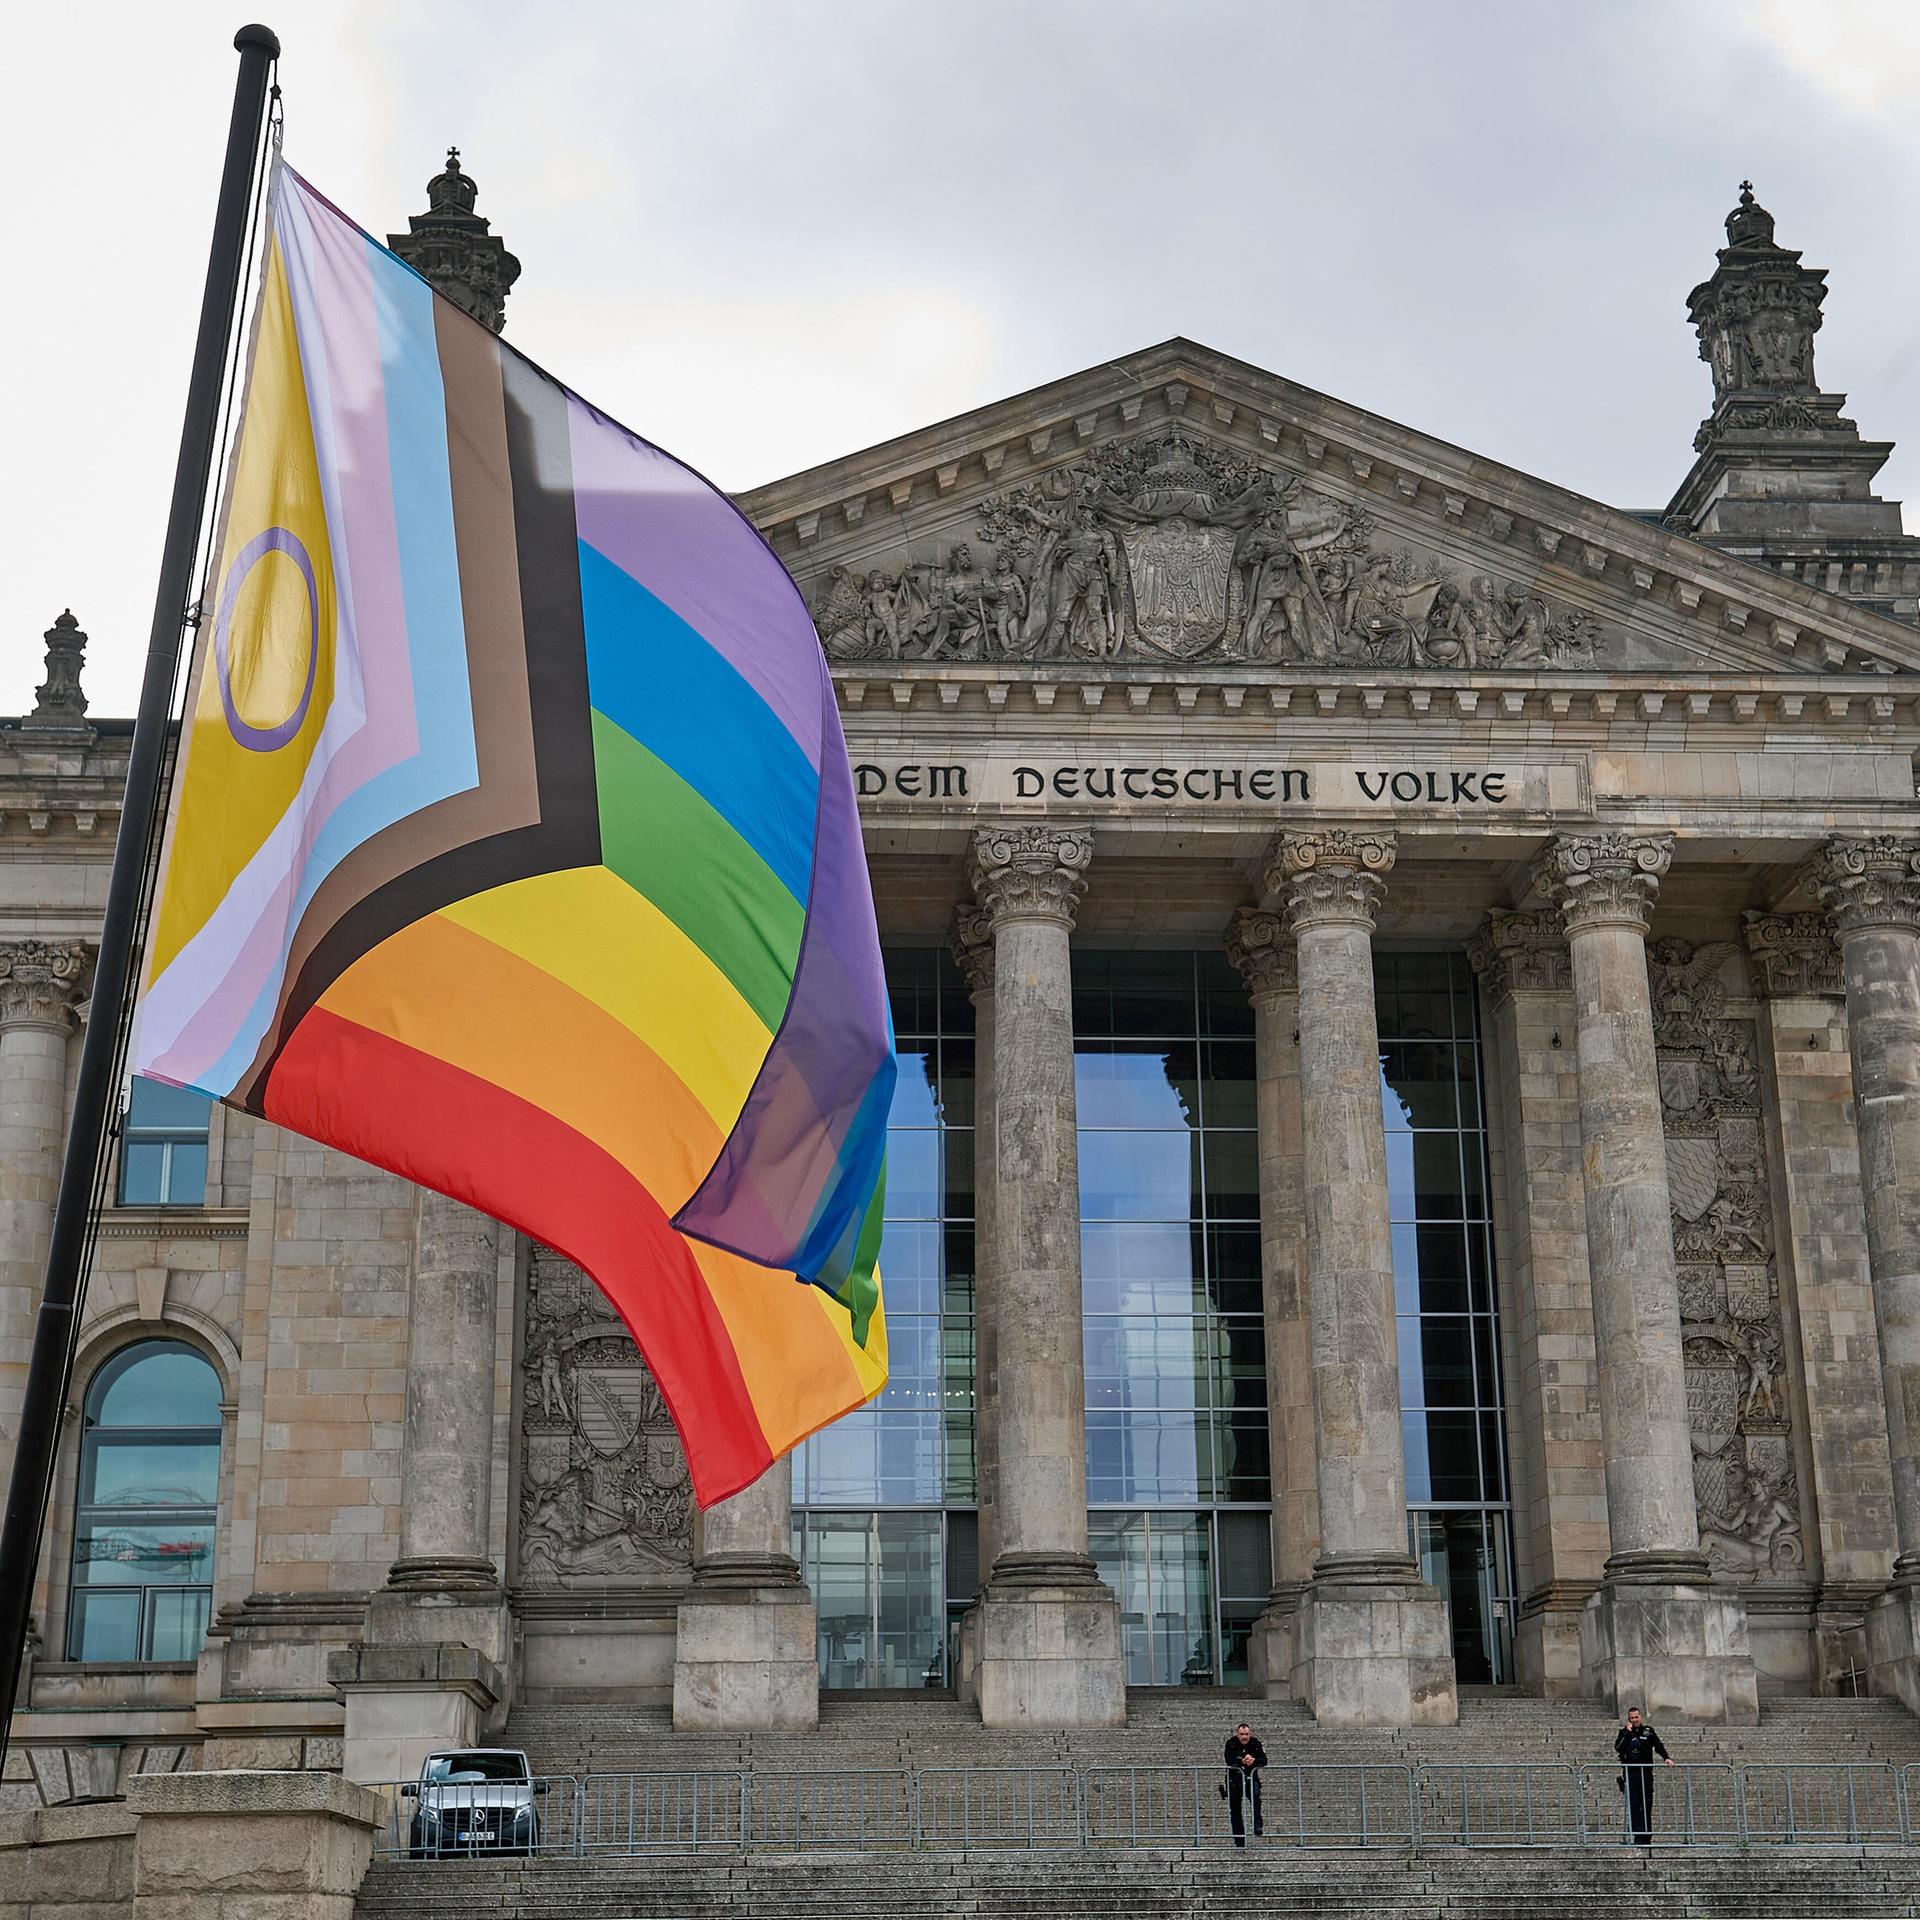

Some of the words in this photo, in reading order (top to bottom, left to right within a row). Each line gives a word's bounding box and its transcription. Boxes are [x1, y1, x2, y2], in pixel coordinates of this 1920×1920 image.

[854, 764, 968, 798] DEM
[1012, 766, 1311, 801] DEUTSCHEN
[1355, 771, 1508, 804] VOLKE
